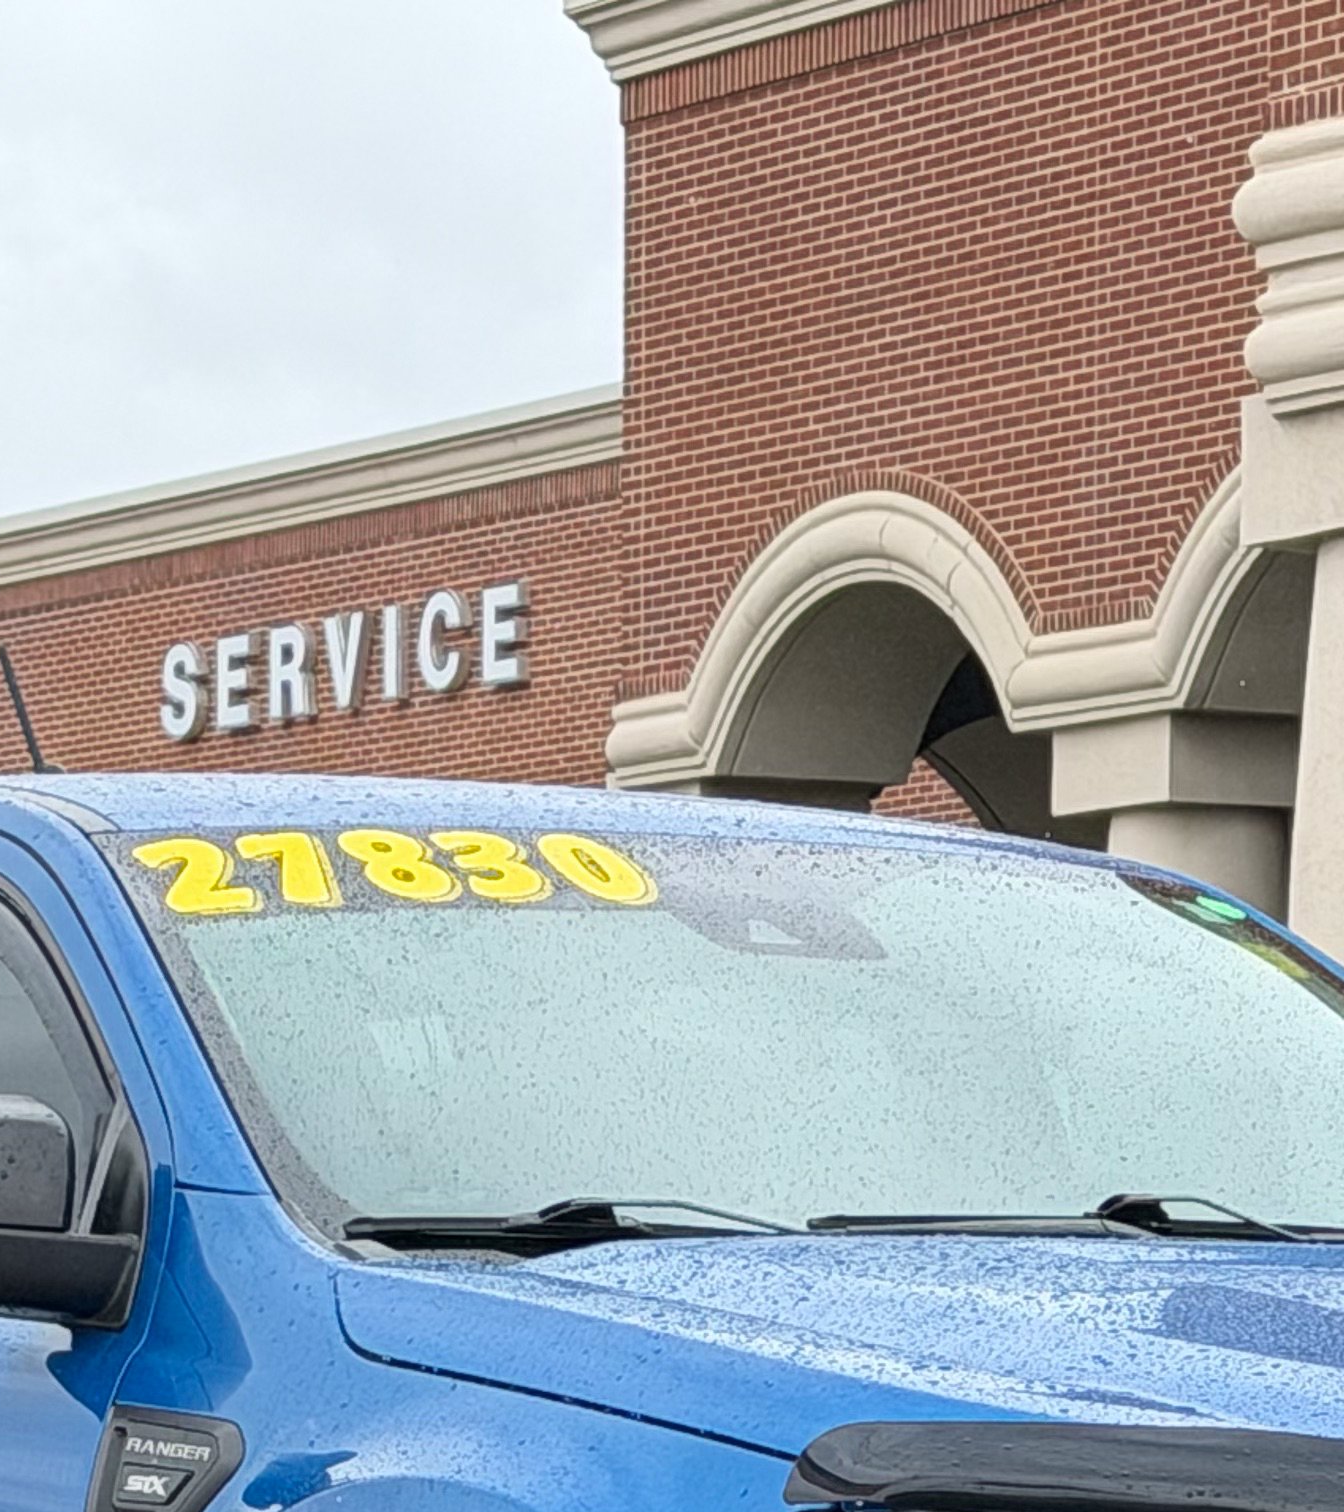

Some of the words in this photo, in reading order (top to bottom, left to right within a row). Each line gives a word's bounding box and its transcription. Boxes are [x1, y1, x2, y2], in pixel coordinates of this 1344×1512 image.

[160, 578, 528, 742] SERVICE
[132, 831, 658, 915] 27830
[125, 1436, 212, 1462] RANGER
